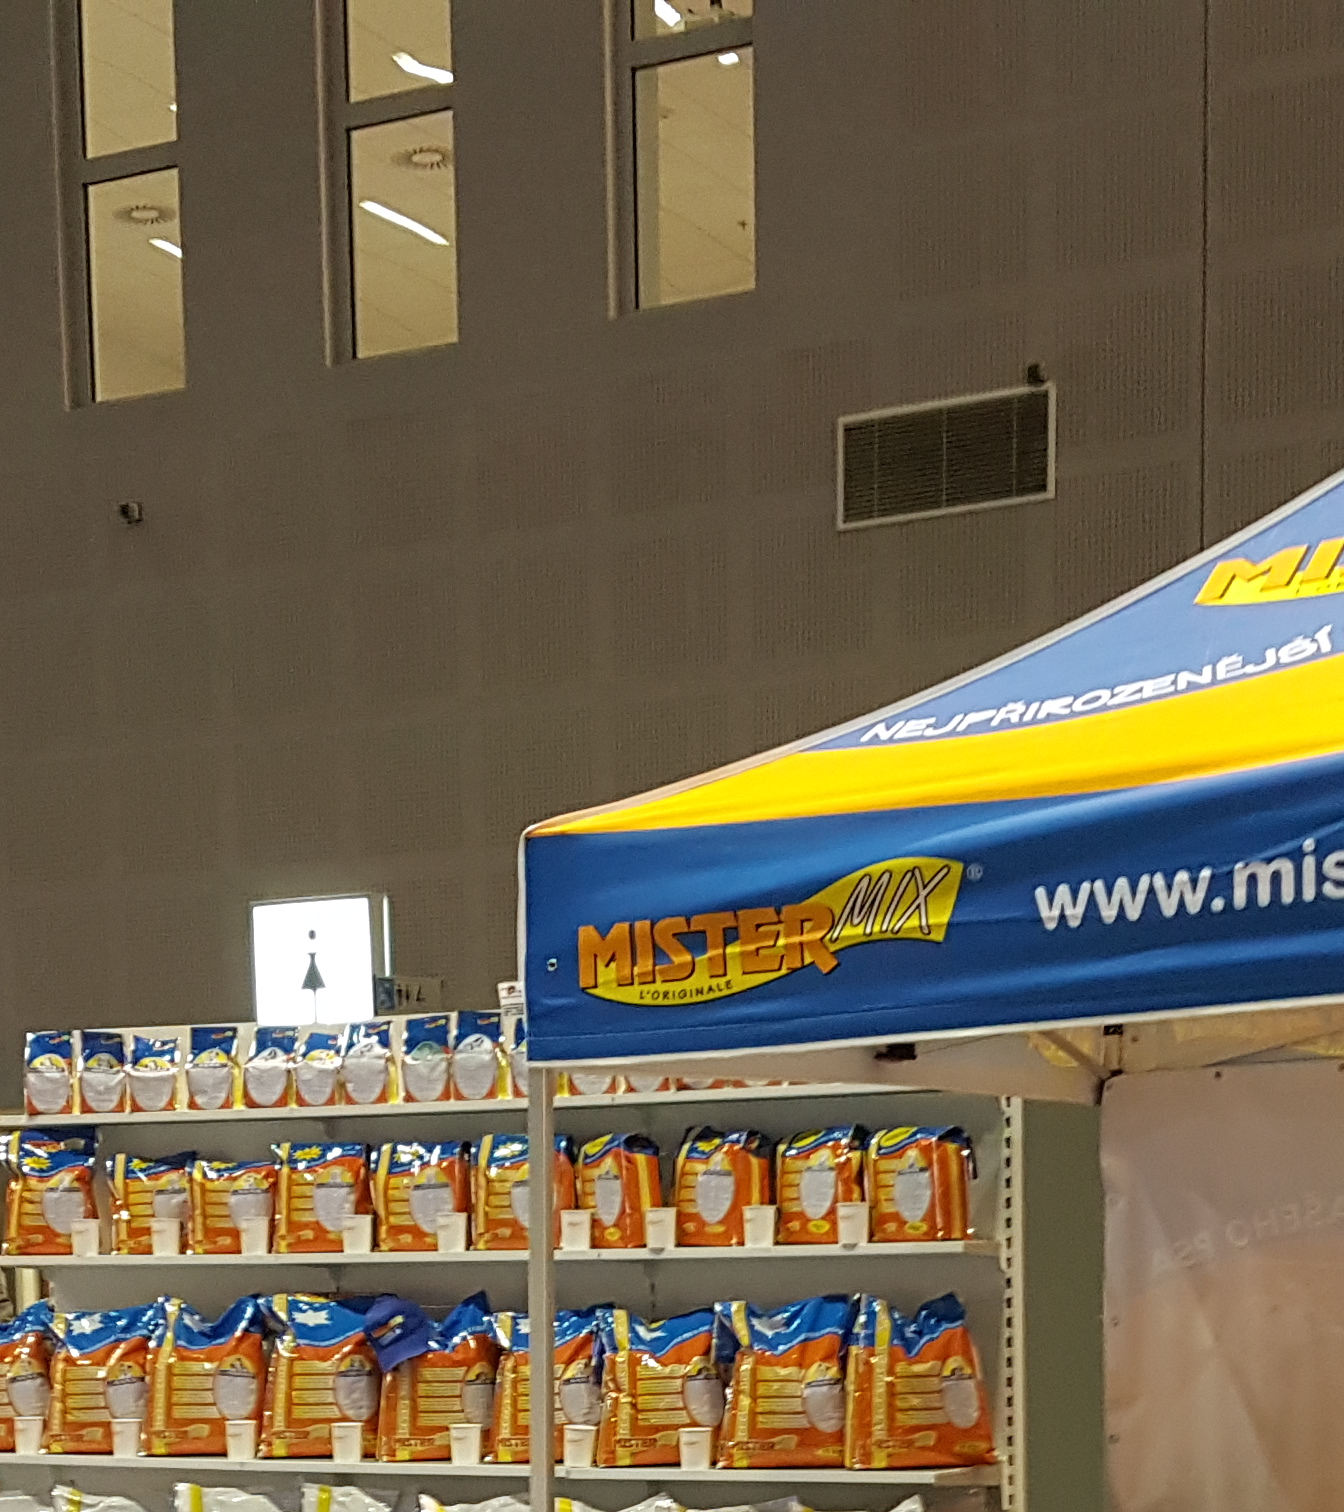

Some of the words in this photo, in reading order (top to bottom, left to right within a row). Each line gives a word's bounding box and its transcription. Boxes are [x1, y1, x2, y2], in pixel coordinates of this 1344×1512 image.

[576, 902, 842, 990] MISTER
[830, 863, 952, 944] MIX
[638, 979, 734, 1002] L'ORIGINALE
